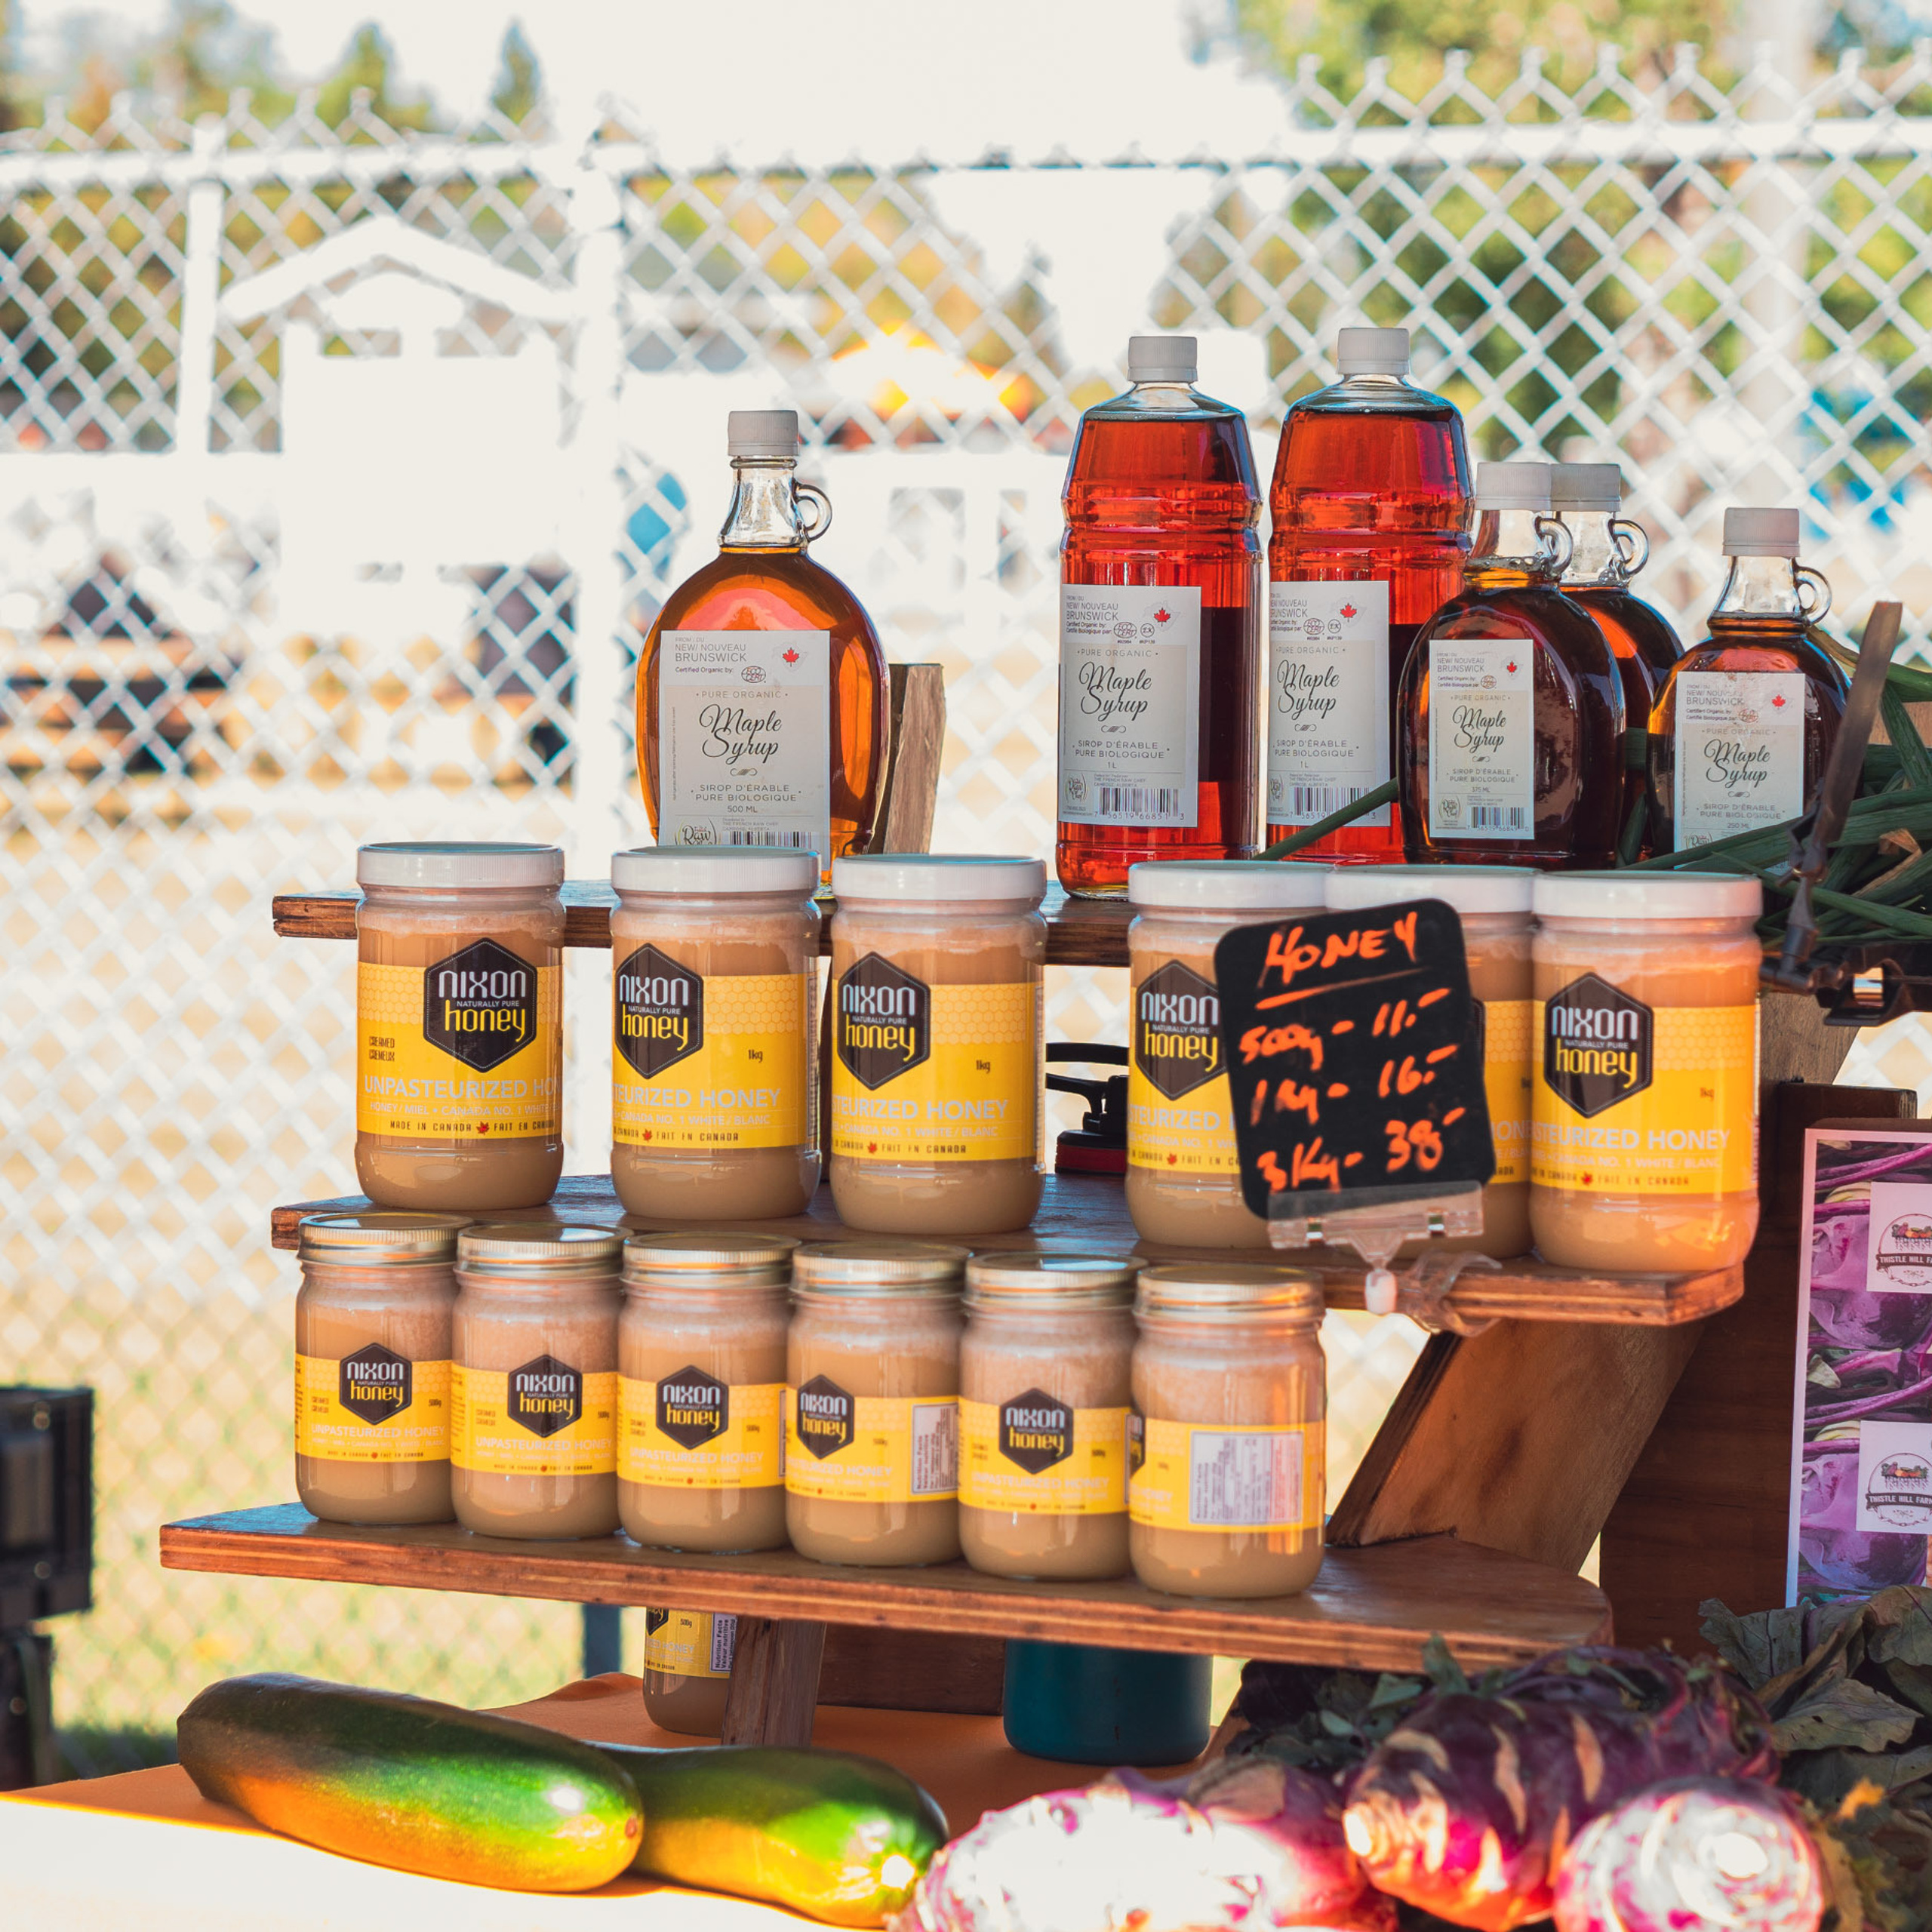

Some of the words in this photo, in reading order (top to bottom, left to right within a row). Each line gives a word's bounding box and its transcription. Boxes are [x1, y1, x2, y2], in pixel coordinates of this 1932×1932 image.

[1066, 611, 1119, 621] BRUNSWICK
[675, 653, 747, 662] BRUNSWICK
[1106, 649, 1152, 657] ORGANIC
[1079, 662, 1152, 696] Maple
[1277, 660, 1340, 693] Maple
[1081, 685, 1149, 721] Syrup
[1278, 684, 1337, 720] Syrup
[1687, 697, 1744, 706] BRUNSWICK
[699, 704, 782, 738] Maple
[1452, 706, 1506, 732] Maple
[702, 728, 779, 764] Syrup
[1106, 740, 1158, 749] D'ÉRABLE
[1454, 724, 1504, 753] Syrup
[1704, 739, 1770, 770] Maple
[1706, 758, 1767, 788] Syrup
[736, 783, 789, 792] D'ÉRABLE
[1257, 911, 1417, 989] HONEY
[629, 1006, 660, 1014] NATURALLY
[852, 1016, 885, 1024] NATURALLY
[445, 1000, 525, 1041] honey
[623, 1004, 688, 1051] honey
[1152, 1024, 1187, 1034] NATURALLY
[1190, 1026, 1210, 1035] PURE
[369, 1036, 395, 1048] CREAMED
[846, 1014, 915, 1062] honey
[1145, 1023, 1218, 1072] honey
[1564, 1039, 1605, 1049] NATURALLY
[1607, 1041, 1629, 1050] PURE
[1556, 1038, 1637, 1088] honey
[365, 1074, 528, 1099] UNPASTEURIZED
[700, 1088, 781, 1108] HONEY
[371, 1102, 398, 1113] HONEY
[405, 1105, 429, 1115] MIEL
[441, 1106, 490, 1116] CANADA
[494, 1106, 513, 1115] NO.
[621, 1111, 653, 1122] CANADA
[657, 1115, 675, 1124] NO.
[688, 1115, 724, 1125] WHITE
[734, 1115, 770, 1124] BLANC
[928, 1100, 1008, 1120] HONEY
[390, 1121, 411, 1130] MADE
[417, 1122, 426, 1131] IN
[433, 1123, 472, 1132] CANADA
[494, 1122, 513, 1131] FAIT
[518, 1121, 528, 1131] EN
[657, 1131, 674, 1140] FAIT
[700, 1132, 739, 1141] CANADA
[881, 1126, 900, 1136] NO.
[915, 1128, 952, 1137] WHITE
[962, 1127, 998, 1137] BLANC
[926, 1145, 966, 1154] CANADA
[1182, 1137, 1203, 1148] NO.
[1648, 1129, 1731, 1151] HONEY
[1598, 1156, 1622, 1168] NO.
[1636, 1157, 1673, 1168] WHITE
[1684, 1157, 1720, 1168] BLANC
[351, 1380, 403, 1407] honey
[520, 1392, 574, 1420] honey
[666, 1403, 719, 1432] honey
[311, 1424, 401, 1438] UNPASTEURIZED
[405, 1426, 445, 1437] HONEY
[803, 1412, 846, 1444] honey
[475, 1436, 571, 1451] UNPASTEURIZED
[574, 1438, 612, 1450] HONEY
[1009, 1426, 1064, 1457] honey
[721, 1452, 764, 1464] HONEY
[663, 1641, 694, 1654] HONEY
